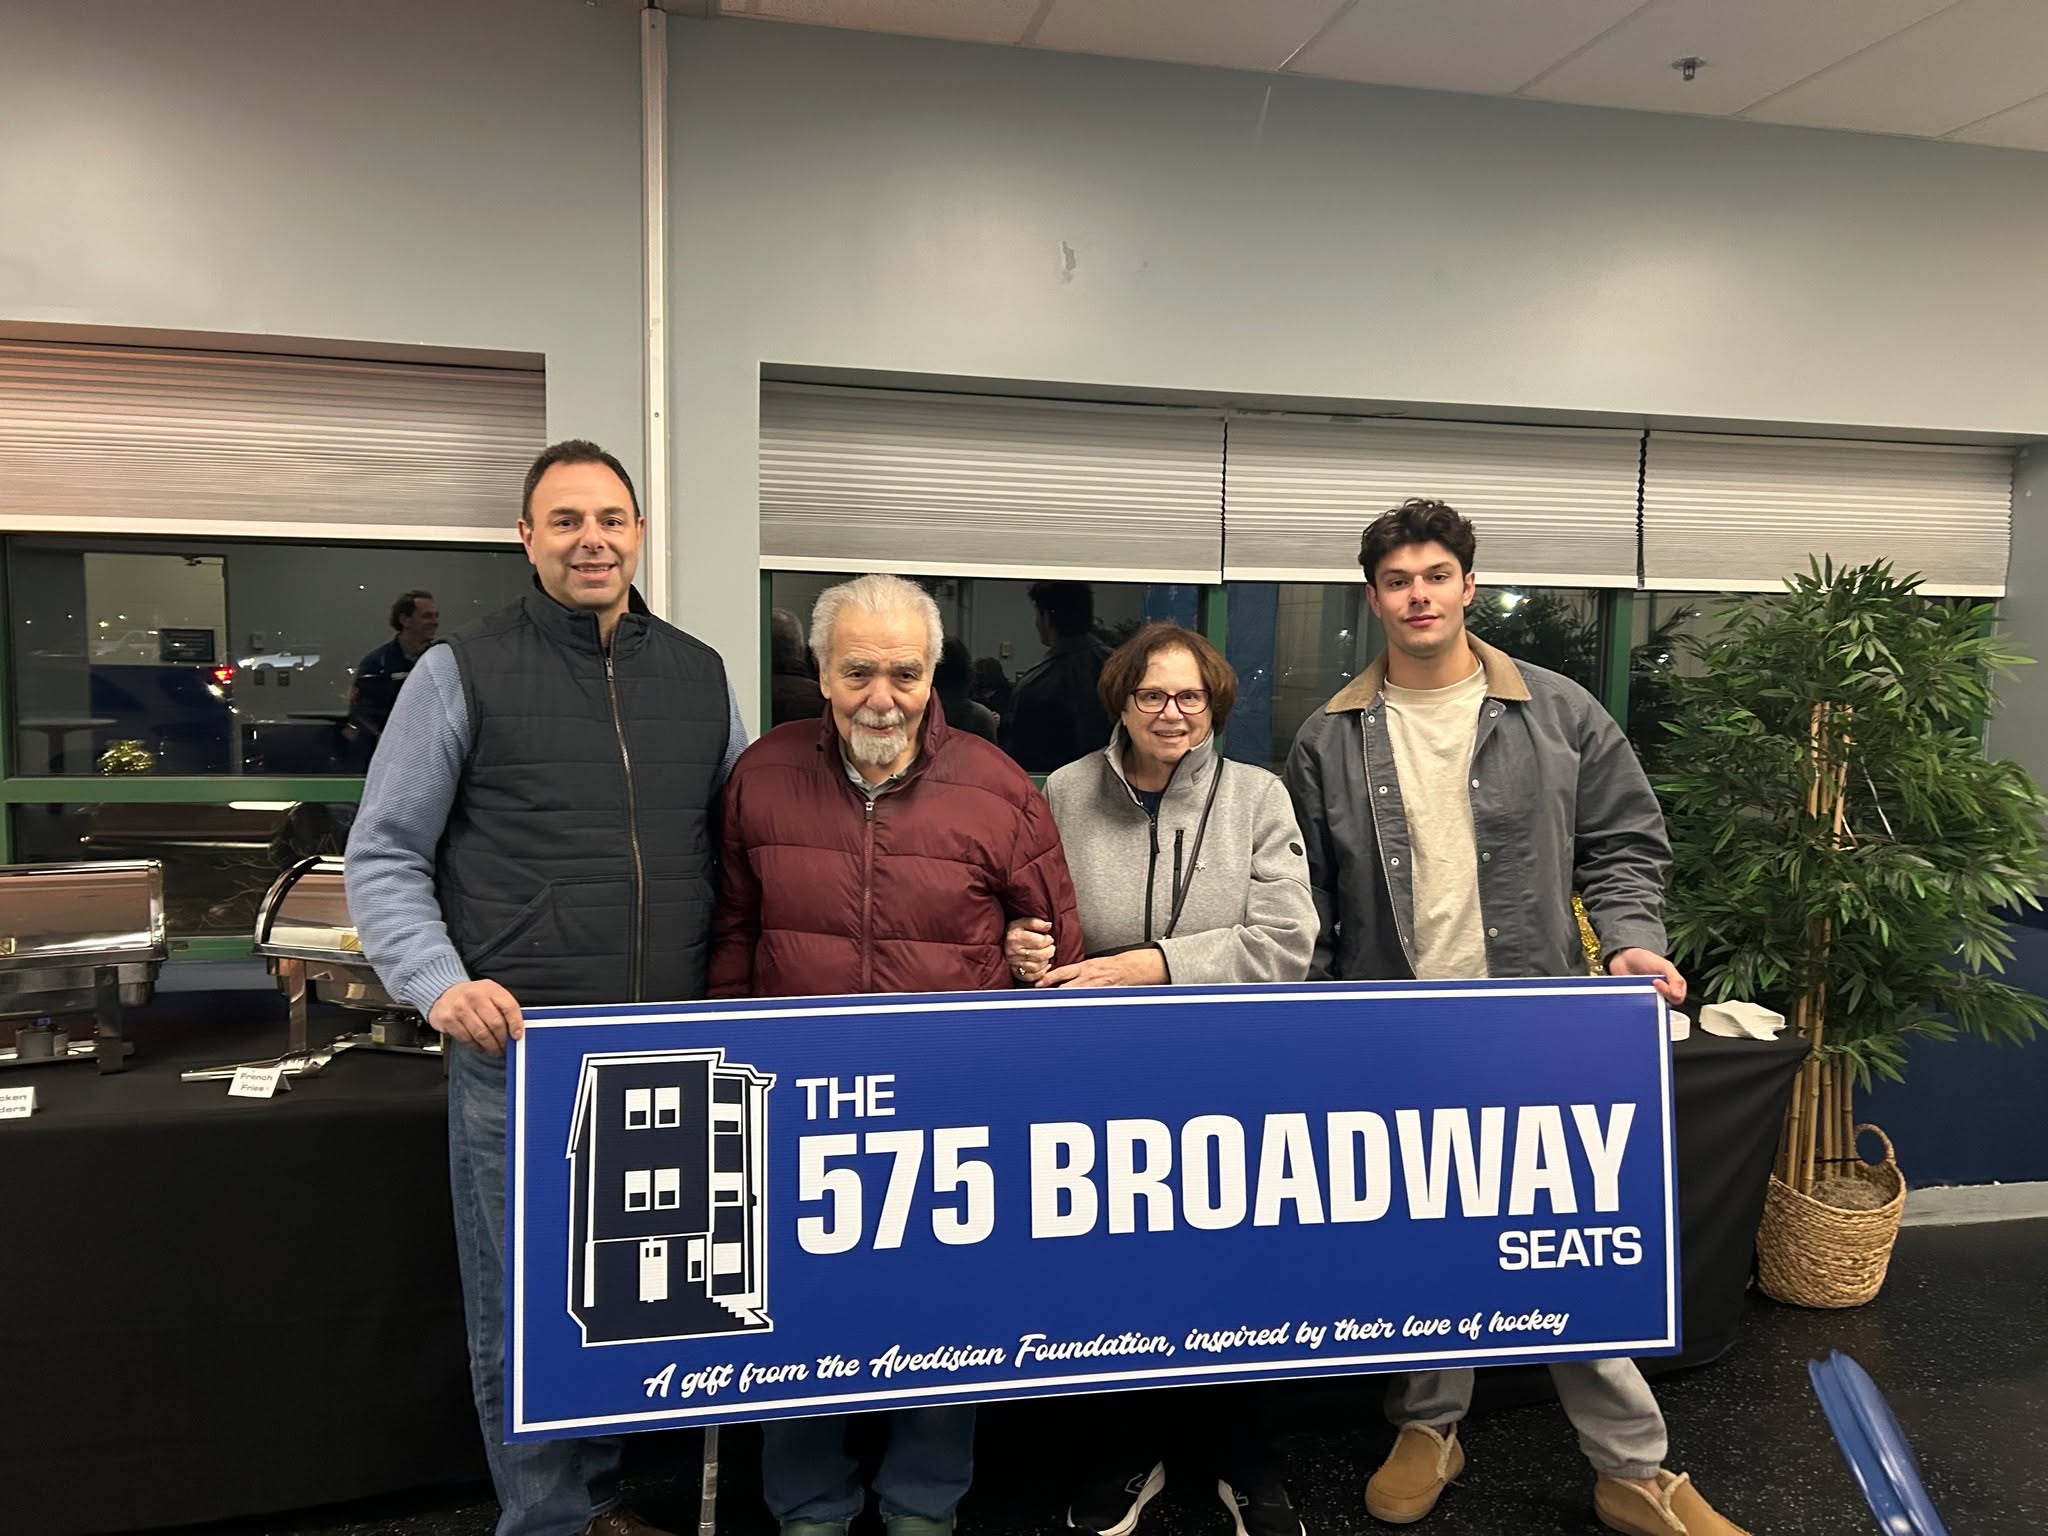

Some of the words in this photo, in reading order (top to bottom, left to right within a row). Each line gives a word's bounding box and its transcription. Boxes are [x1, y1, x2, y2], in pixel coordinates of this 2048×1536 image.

[240, 1072, 273, 1081] French
[240, 1083, 265, 1091] Fries
[795, 1074, 896, 1121] THE
[797, 1125, 995, 1255] 575
[1029, 1102, 1637, 1239] BROADWAY
[1498, 1225, 1643, 1271] SEATS
[643, 1363, 677, 1398] A
[681, 1363, 735, 1399] gift
[738, 1361, 810, 1393] from
[816, 1354, 860, 1379] the
[868, 1344, 1007, 1379] Avedisian
[1014, 1331, 1176, 1368] Foundation,
[1184, 1321, 1291, 1353] inspired
[1294, 1321, 1328, 1350] by
[1333, 1317, 1396, 1342] their
[1402, 1315, 1452, 1337] love
[1457, 1312, 1483, 1341] of
[1488, 1308, 1570, 1336] hockey
